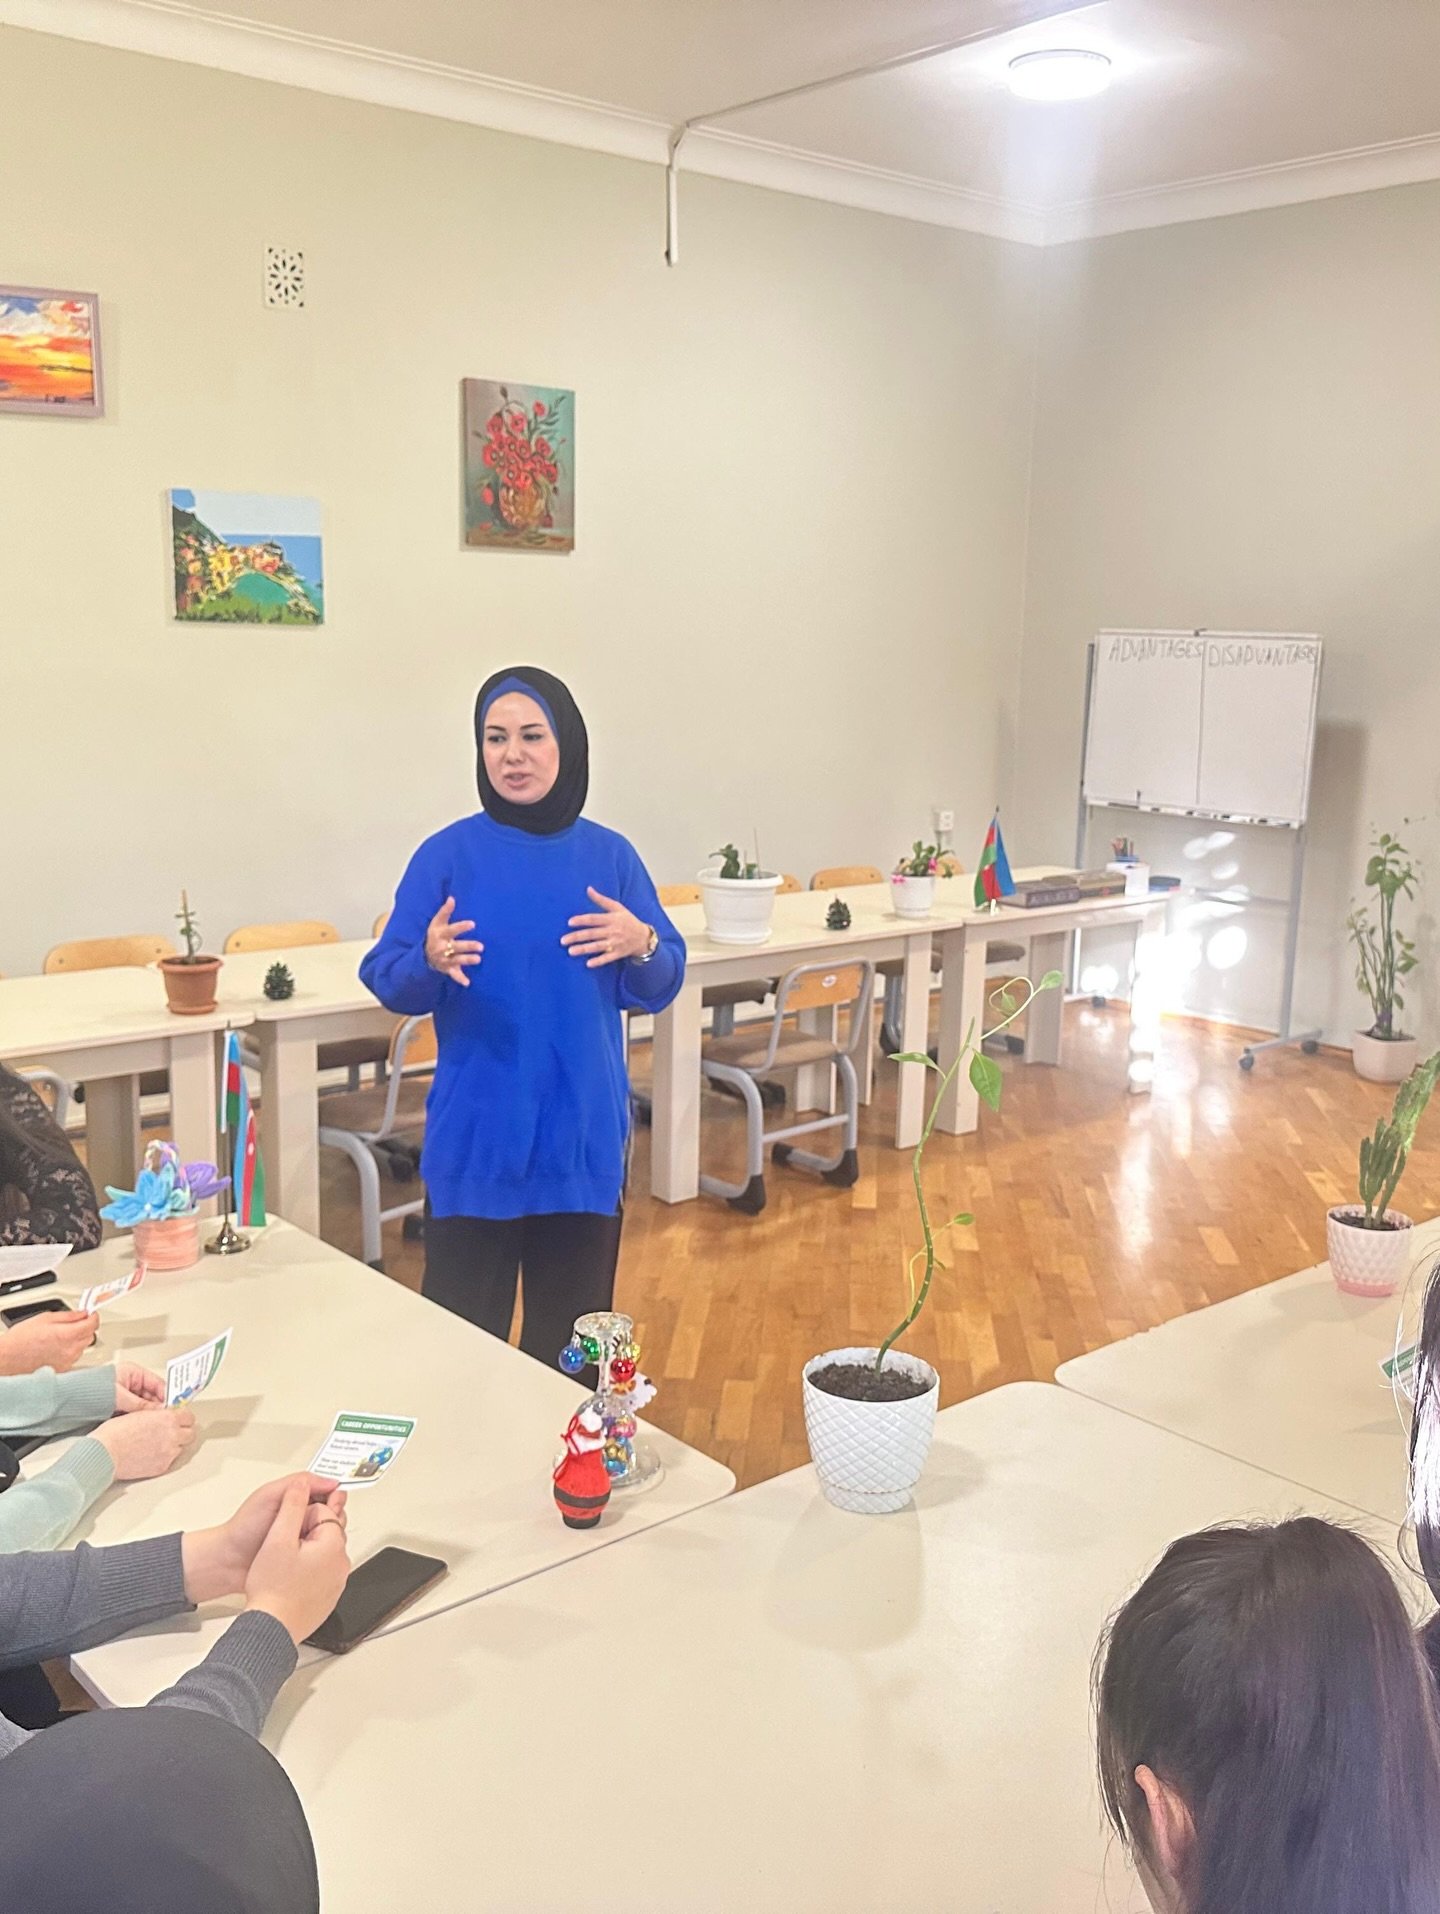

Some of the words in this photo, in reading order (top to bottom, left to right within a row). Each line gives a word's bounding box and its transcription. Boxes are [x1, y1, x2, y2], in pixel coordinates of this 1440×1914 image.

[1109, 638, 1203, 662] ADVANTAGES
[341, 1420, 362, 1428] CAREER
[363, 1422, 407, 1432] OPPORTUNITIES
